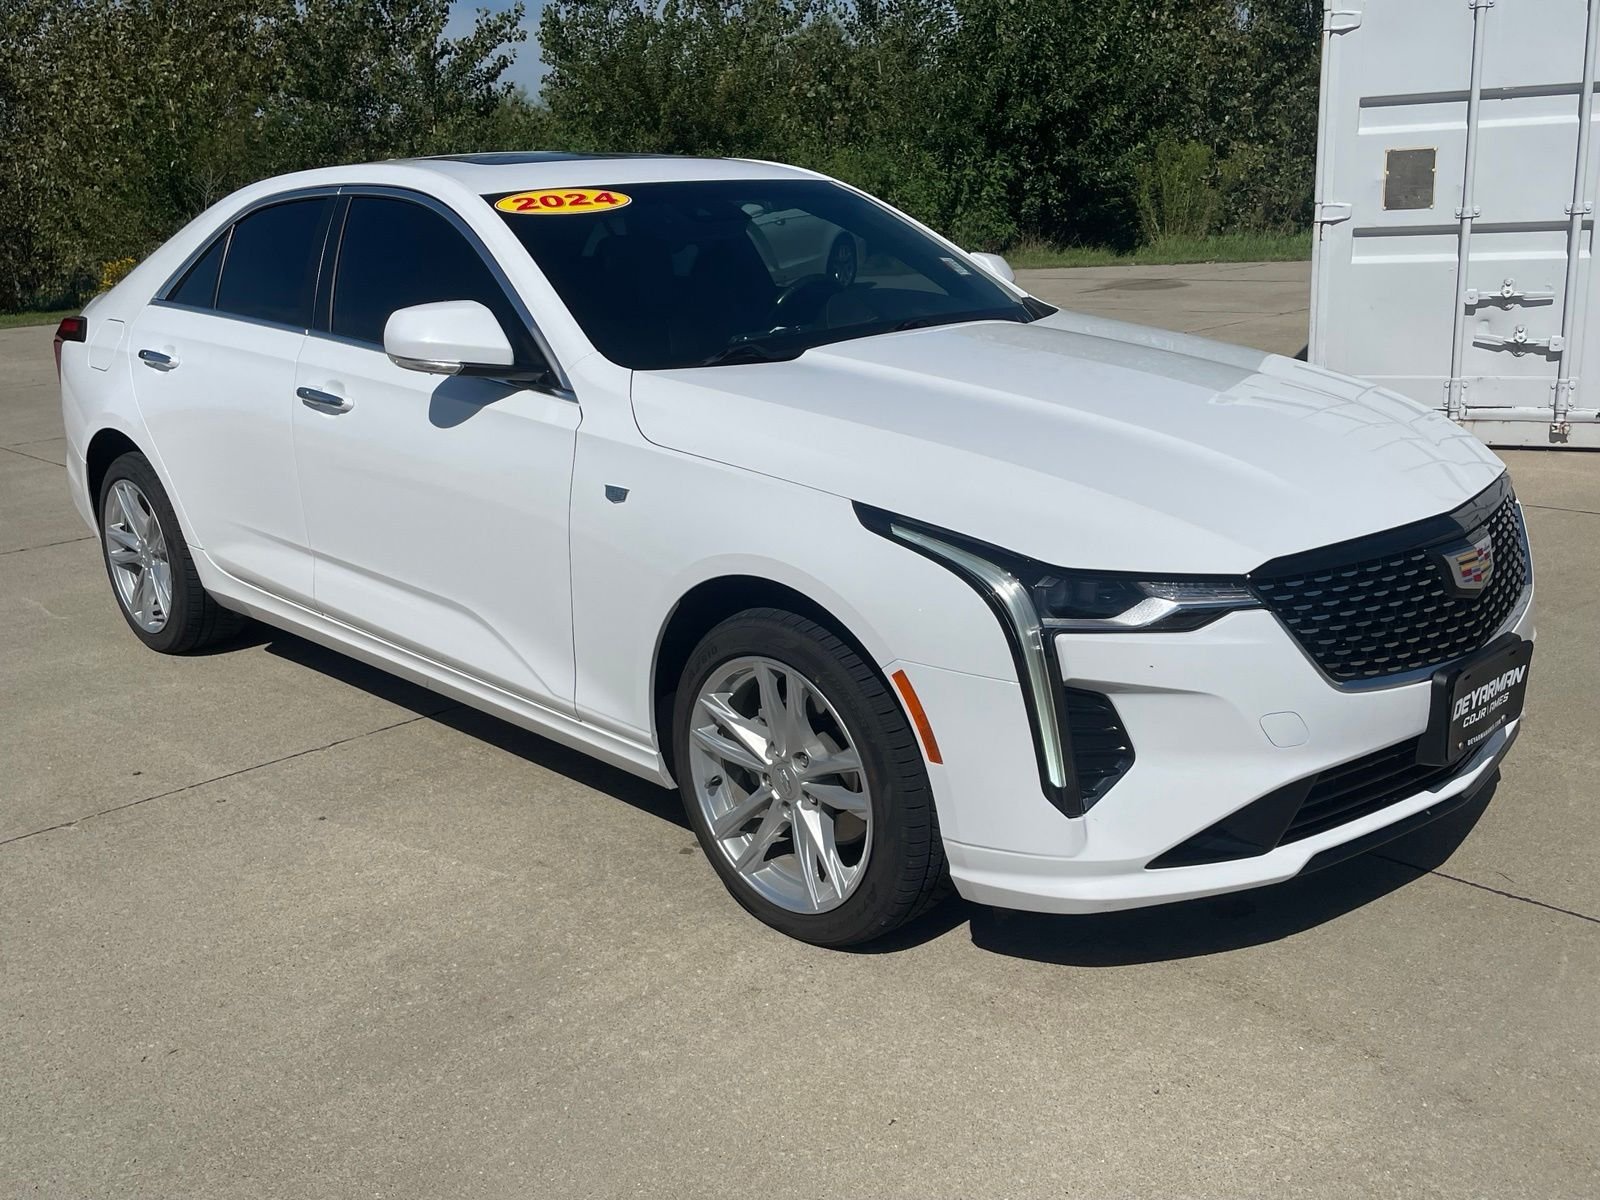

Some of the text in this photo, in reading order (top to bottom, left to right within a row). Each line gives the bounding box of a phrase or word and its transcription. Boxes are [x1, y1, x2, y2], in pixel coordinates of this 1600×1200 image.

[512, 192, 619, 211] 2024
[1453, 665, 1526, 721] DEYARMAN
[1489, 692, 1509, 713] AMES
